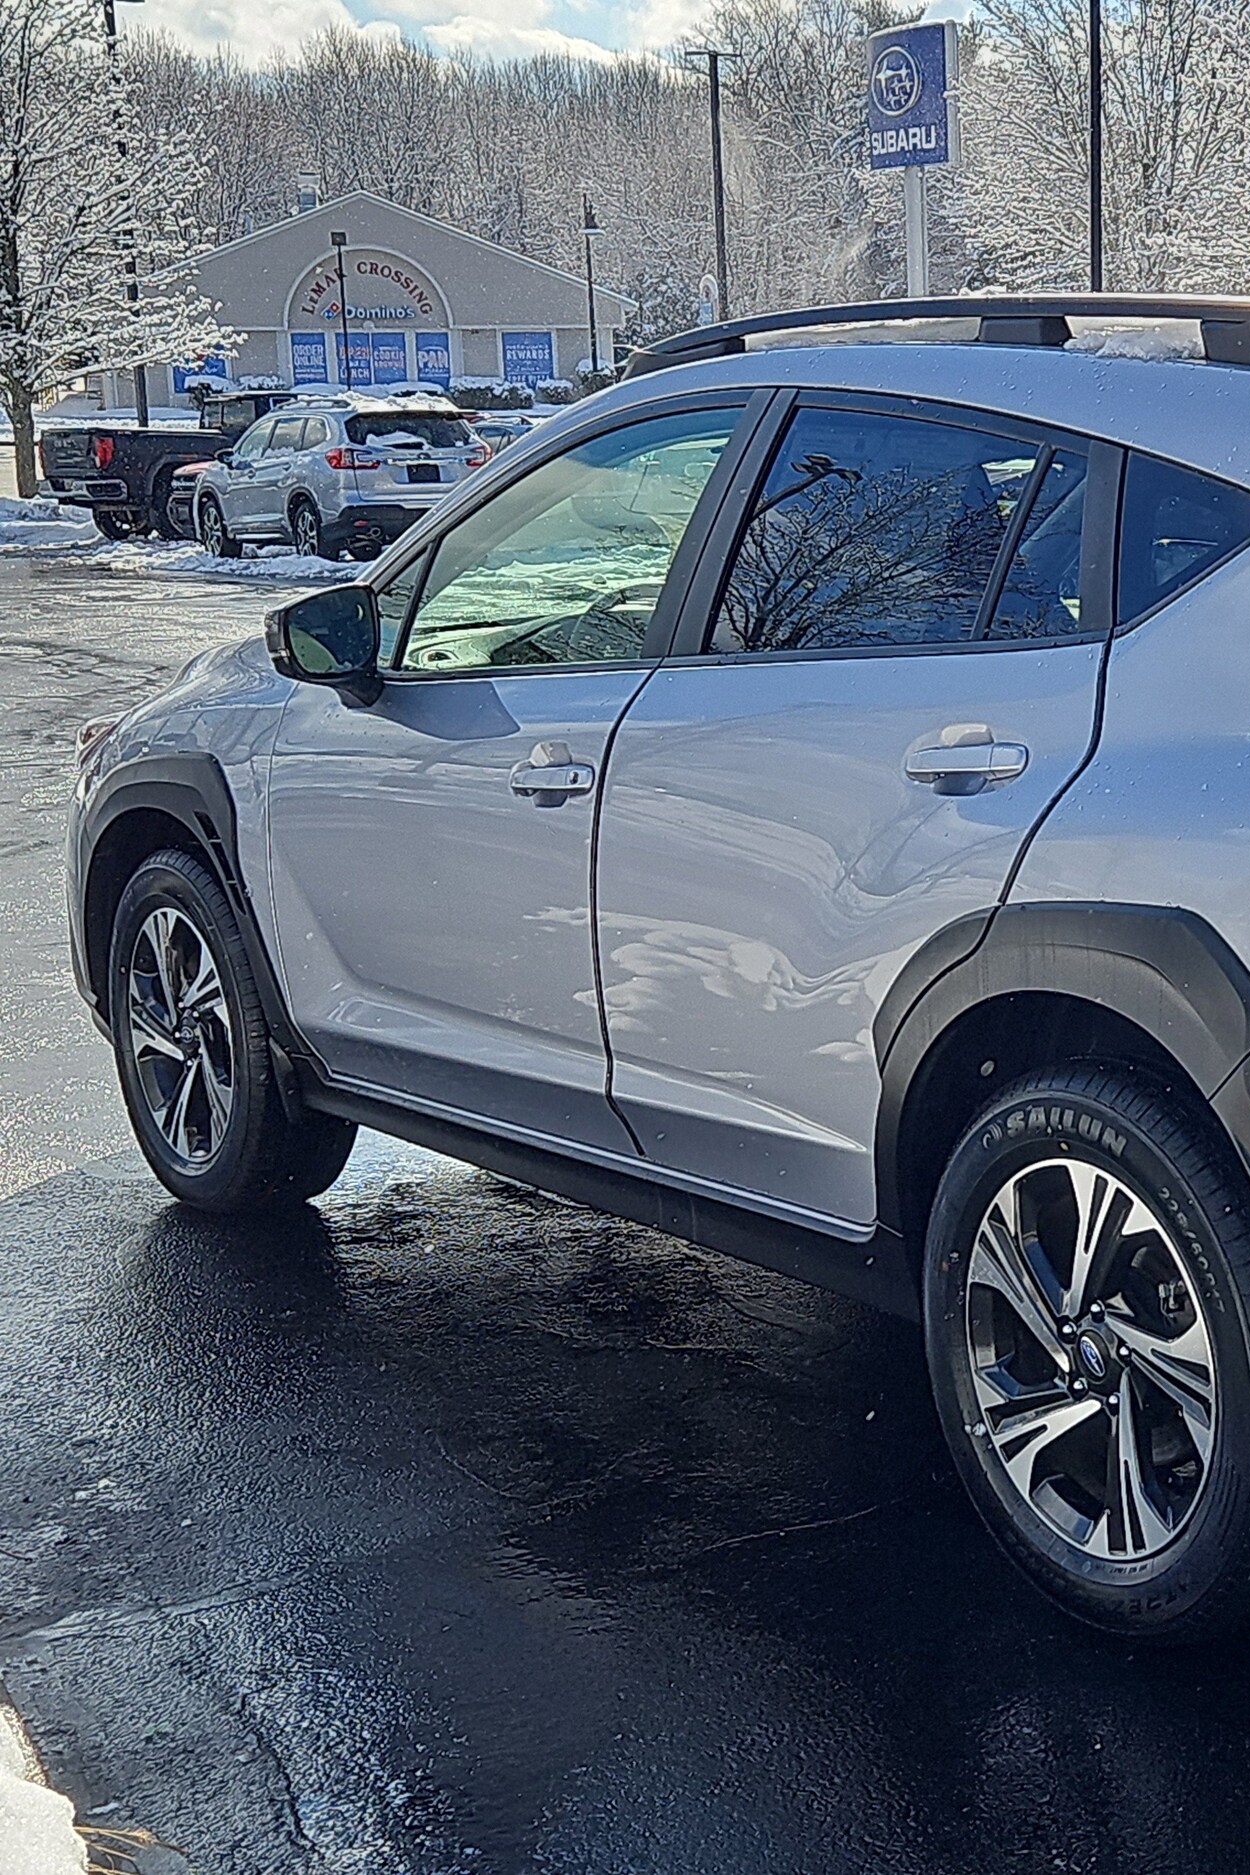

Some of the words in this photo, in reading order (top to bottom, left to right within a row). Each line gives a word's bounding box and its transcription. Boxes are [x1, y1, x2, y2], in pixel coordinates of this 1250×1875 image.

[871, 125, 936, 156] SUBARU
[357, 261, 433, 315] CROSSING
[345, 305, 415, 319] Domino's
[293, 344, 324, 356] ORDER
[418, 350, 448, 369] PAN
[294, 355, 325, 367] ONLINE
[1006, 1106, 1127, 1158] SAILUN
